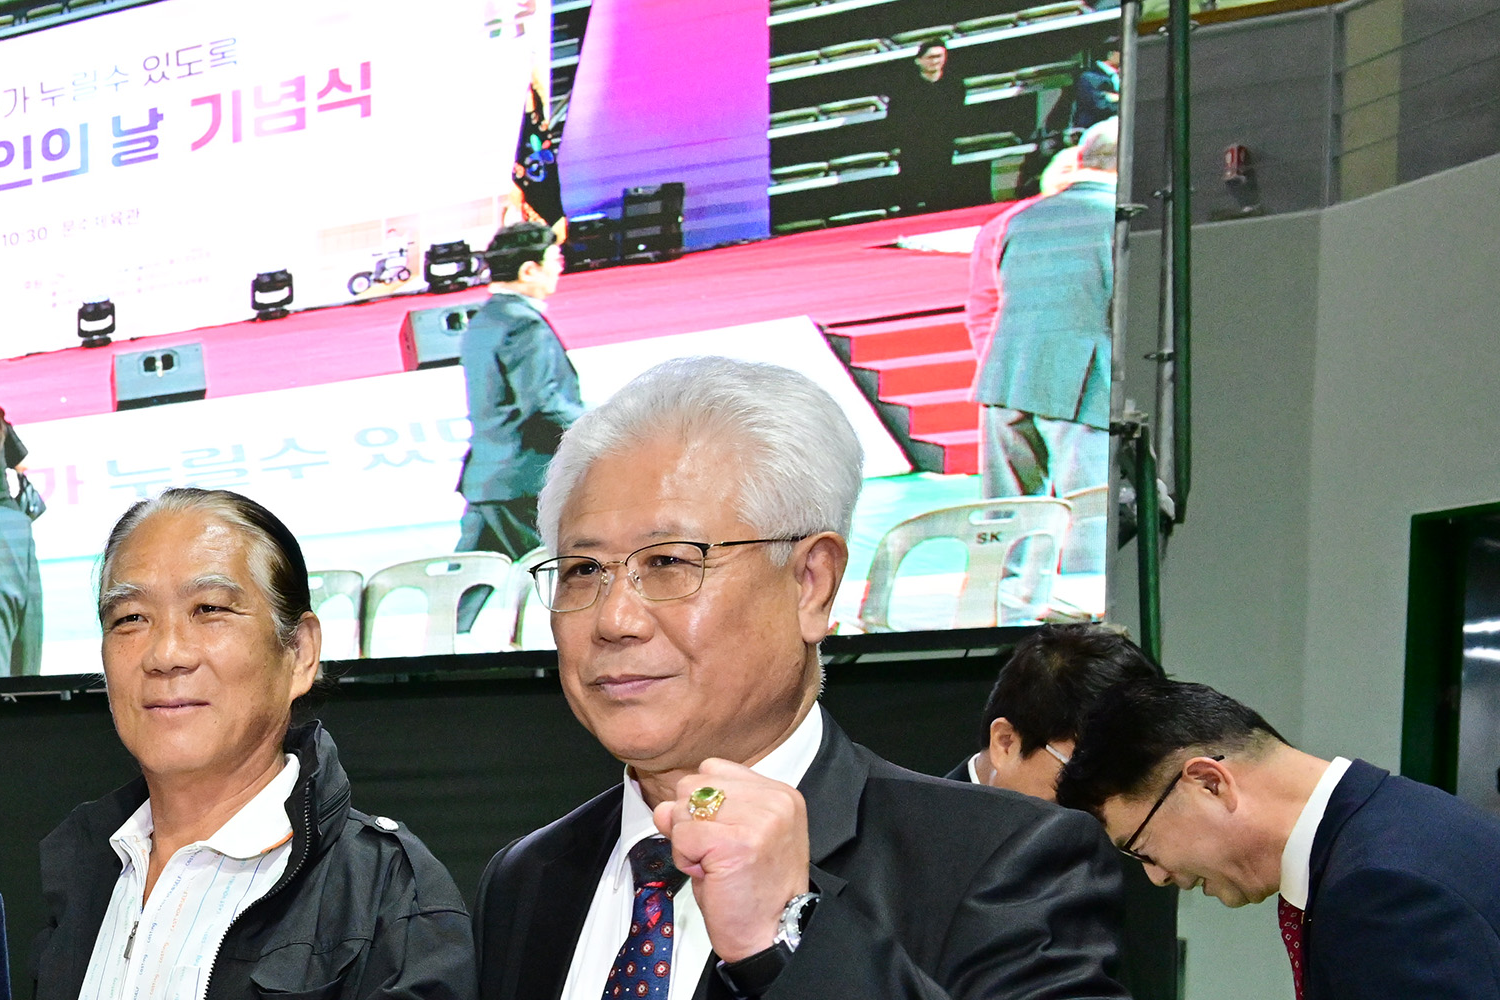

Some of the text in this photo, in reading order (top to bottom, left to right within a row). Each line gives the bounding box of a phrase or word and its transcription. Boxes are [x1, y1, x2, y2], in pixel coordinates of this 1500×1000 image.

[40, 64, 130, 108] 누릴수
[142, 37, 238, 87] 있도록
[111, 107, 164, 168] 날
[190, 60, 372, 152] 기념식
[976, 531, 1002, 545] SK
